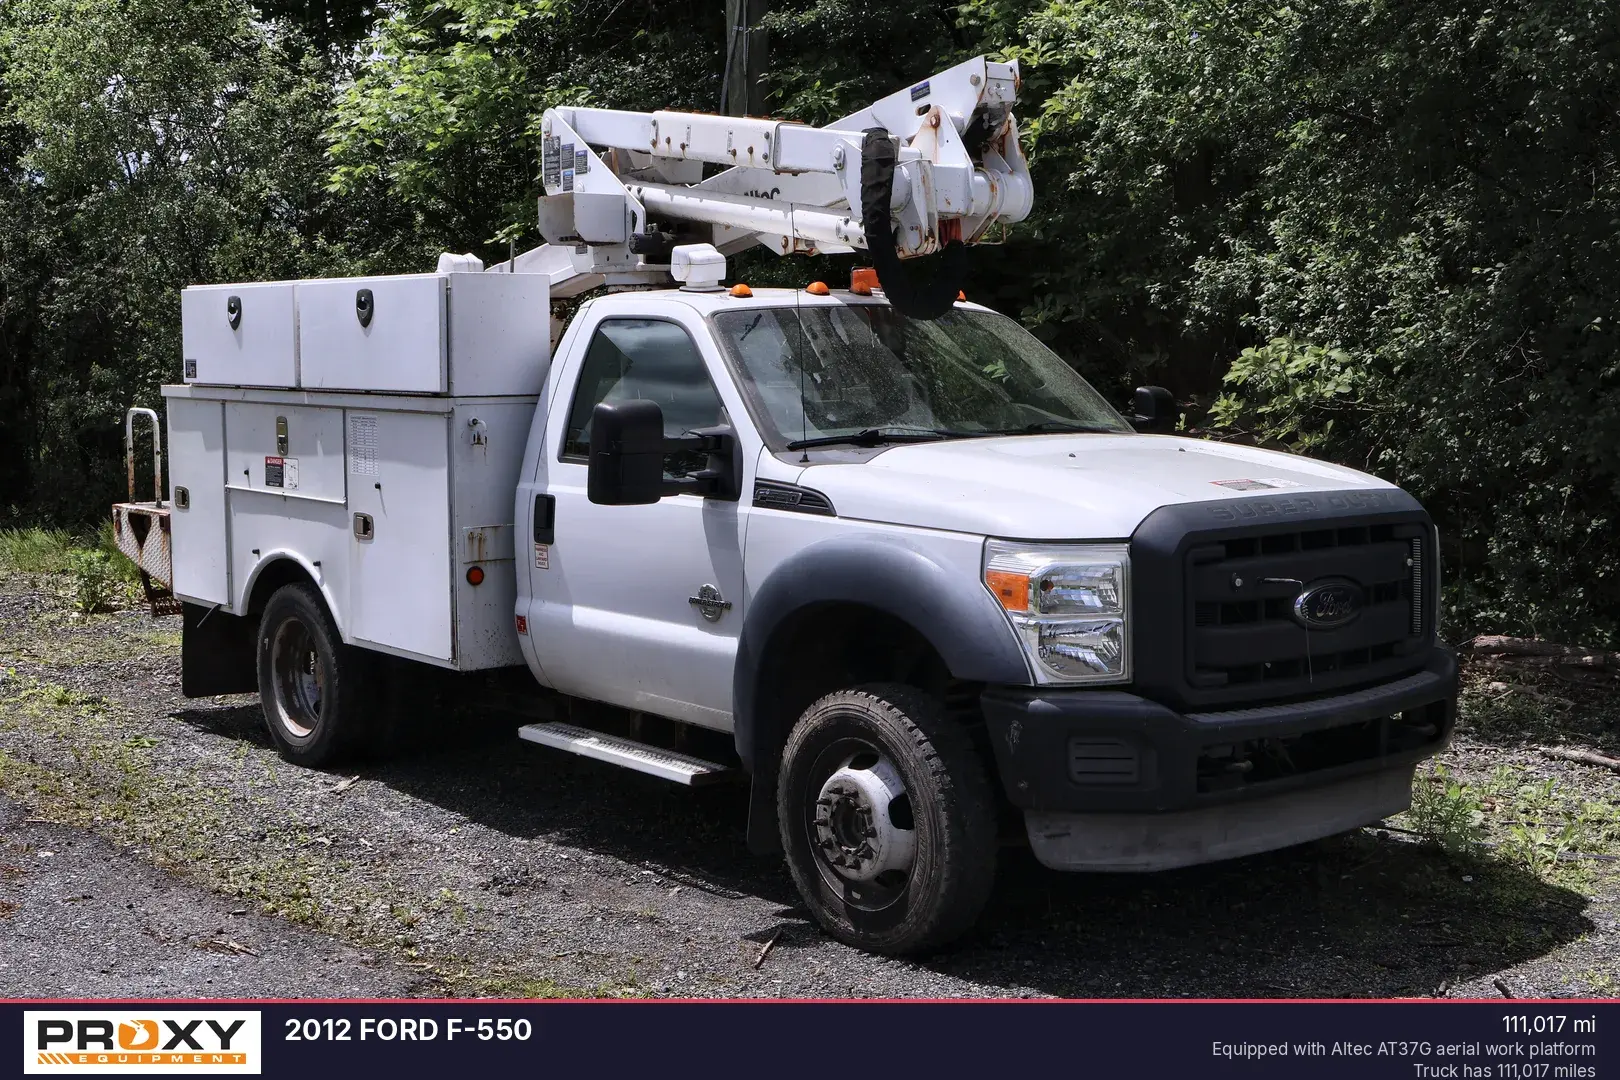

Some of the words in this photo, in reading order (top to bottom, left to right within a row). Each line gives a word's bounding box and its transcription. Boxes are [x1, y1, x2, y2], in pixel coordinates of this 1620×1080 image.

[1207, 498, 1320, 521] SUPER
[1328, 492, 1394, 511] DUTY
[1316, 591, 1352, 618] Ford
